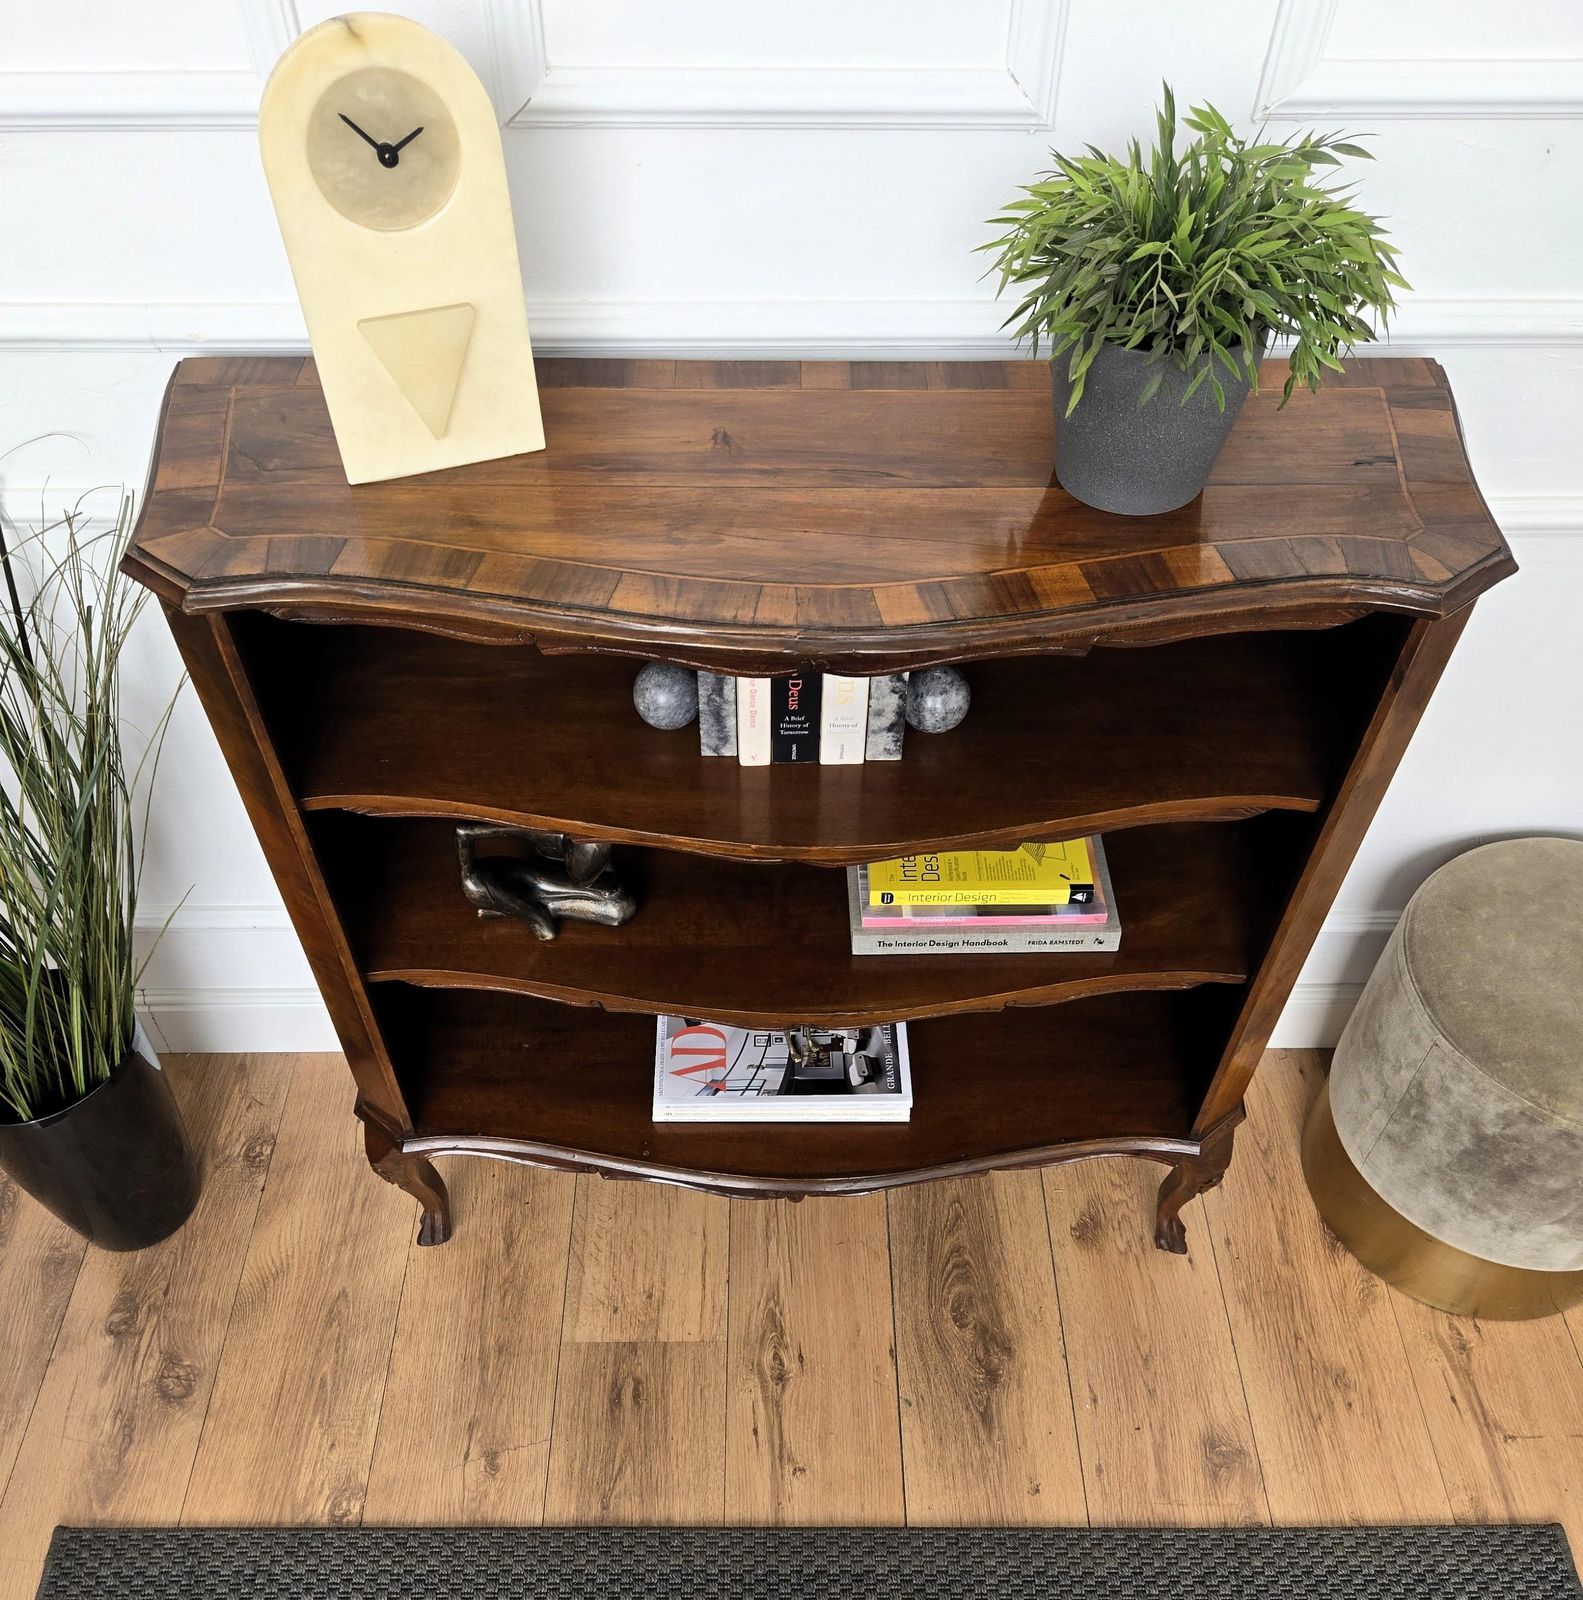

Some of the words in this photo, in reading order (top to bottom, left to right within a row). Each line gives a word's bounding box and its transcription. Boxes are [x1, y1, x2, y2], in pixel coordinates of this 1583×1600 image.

[749, 689, 757, 708] Dance
[788, 679, 803, 711] Deus
[749, 710, 757, 729] Dance
[908, 892, 953, 903] Interior
[955, 892, 997, 904] Design
[894, 940, 928, 948] Interior
[928, 940, 960, 948] Design
[961, 939, 1009, 947] Handbook
[668, 1026, 727, 1093] AD
[885, 1052, 896, 1090] GRANDE
